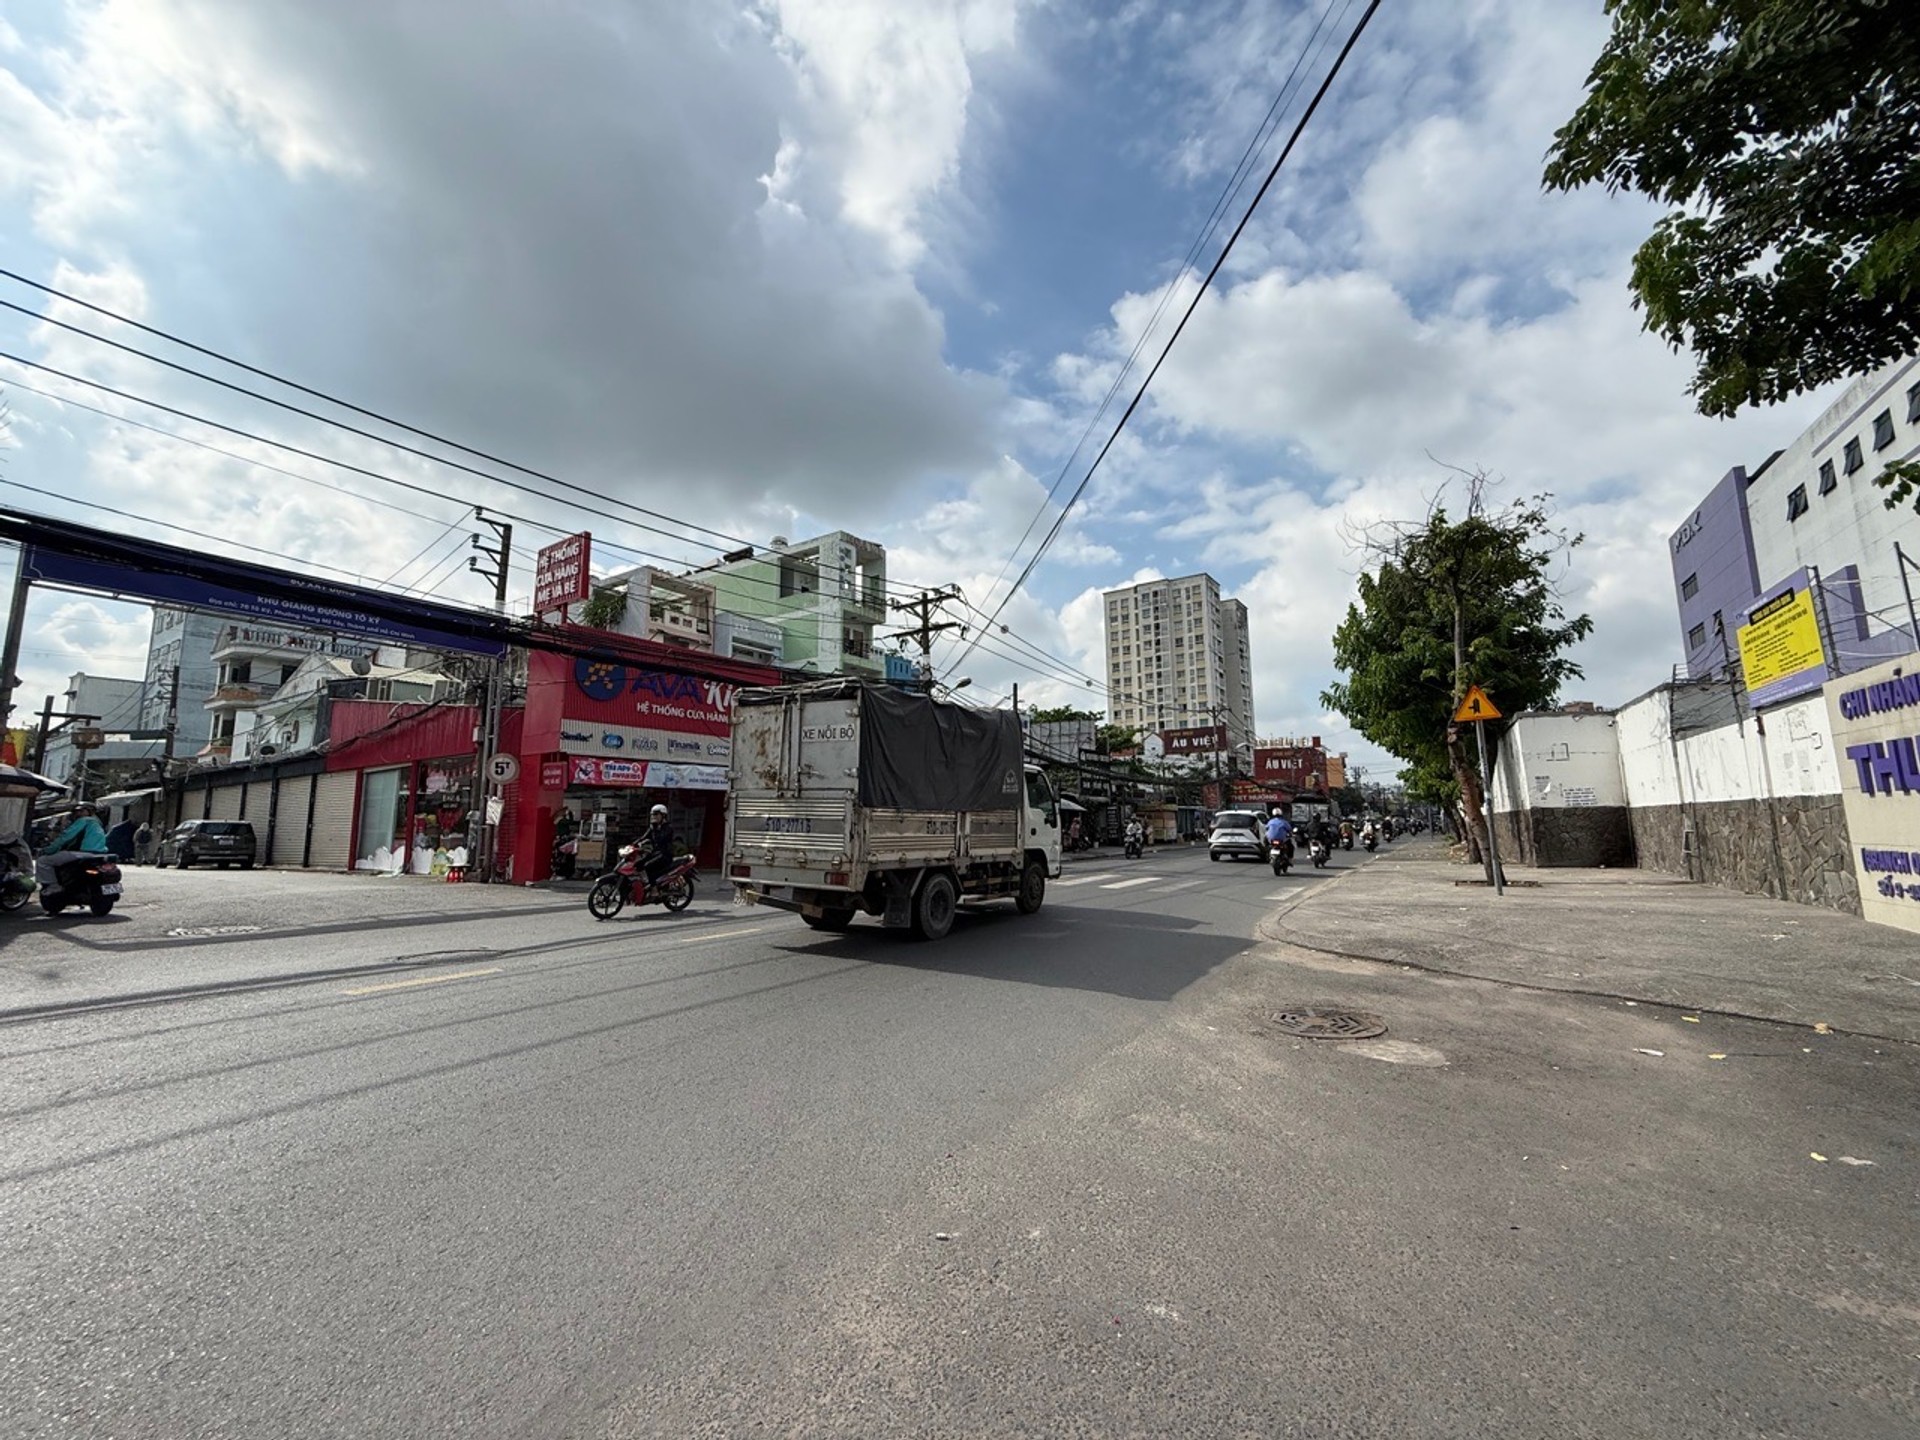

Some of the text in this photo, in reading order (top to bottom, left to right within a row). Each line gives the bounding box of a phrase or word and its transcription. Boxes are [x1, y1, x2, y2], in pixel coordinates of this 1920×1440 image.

[554, 562, 579, 580] HÀNG
[257, 596, 279, 606] KHU
[636, 700, 650, 715] HỆ
[651, 703, 685, 719] THỐNG
[1839, 688, 1870, 721] CHI
[802, 724, 855, 741] XE NỘI BỘ
